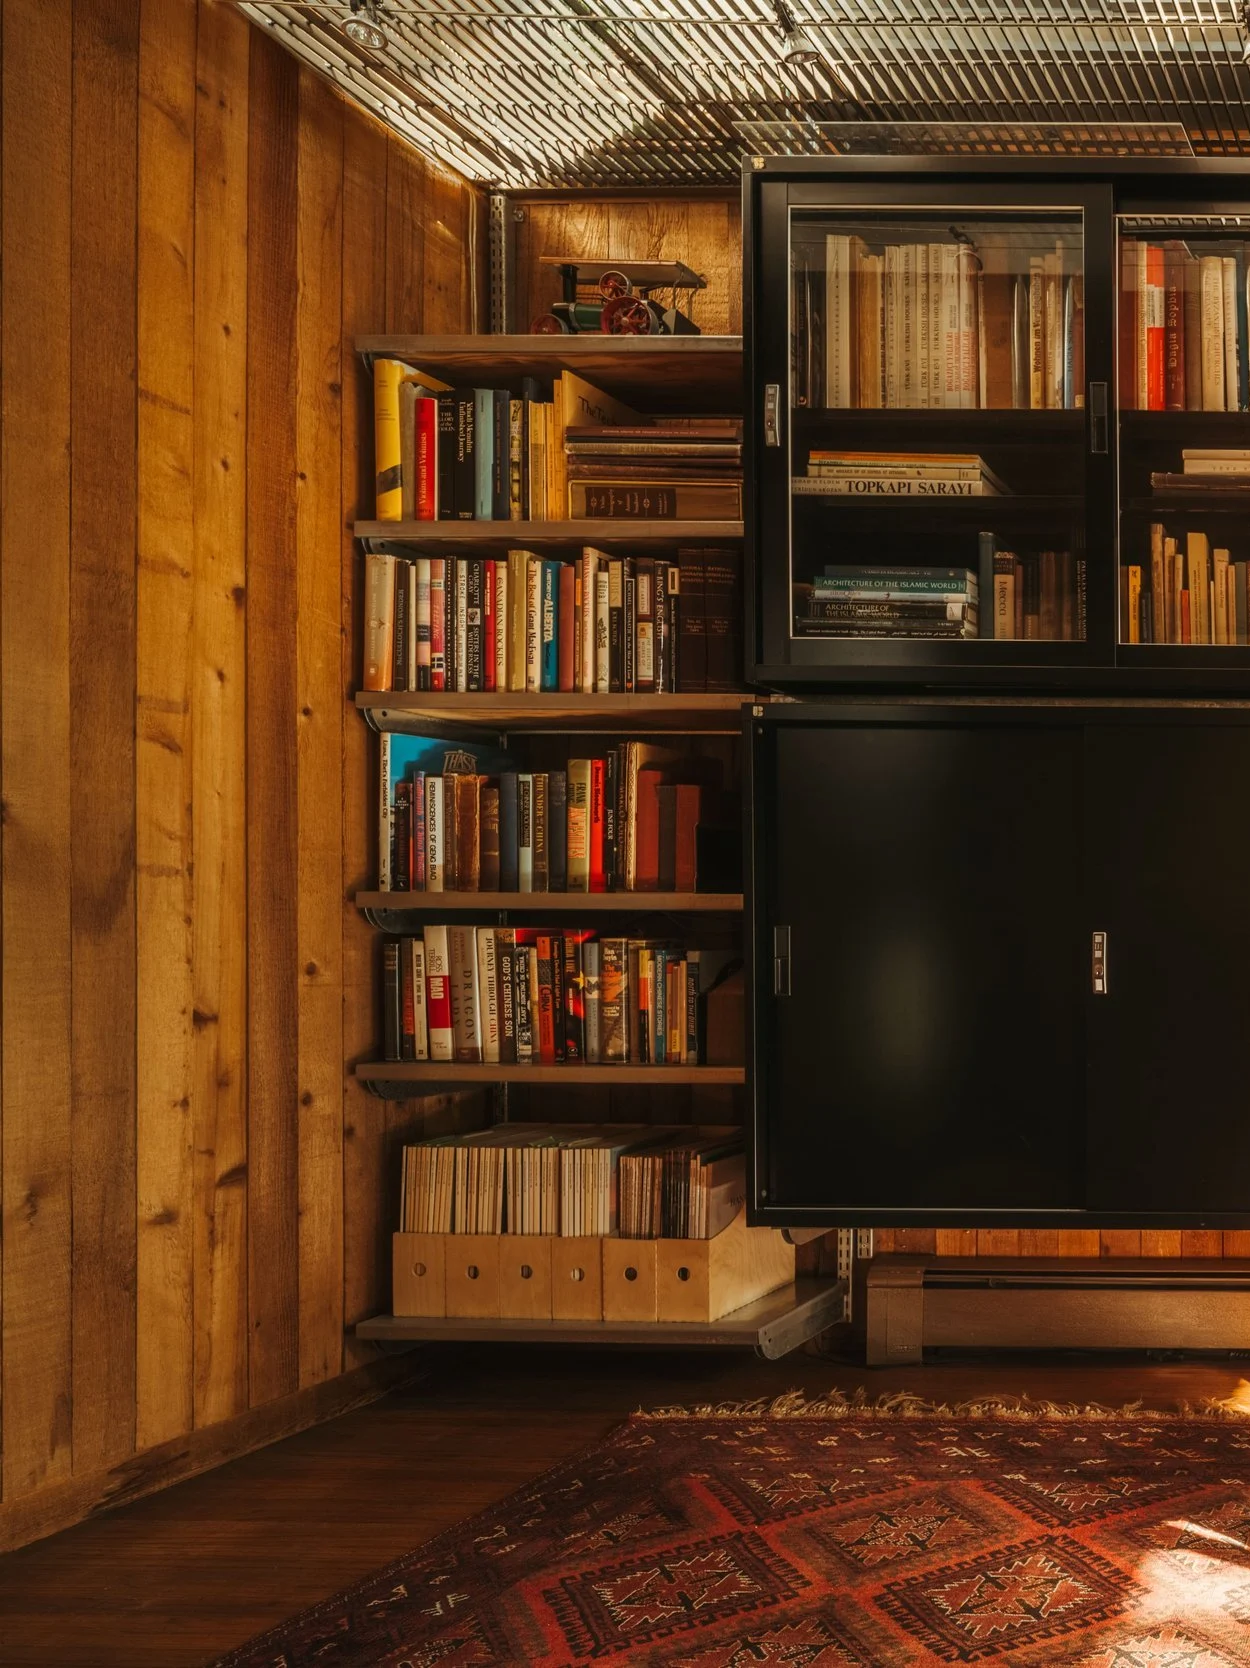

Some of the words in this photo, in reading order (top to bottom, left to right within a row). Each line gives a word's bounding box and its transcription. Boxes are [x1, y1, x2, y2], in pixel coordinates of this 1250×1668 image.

[1033, 341, 1041, 373] Wohnen
[419, 432, 427, 465] Violinists
[457, 437, 466, 463] Journey
[419, 466, 427, 480] and
[419, 480, 427, 505] Violins
[846, 480, 912, 494] TOPKAPI
[917, 481, 973, 495] SARAYI
[527, 569, 537, 583] The
[610, 567, 621, 603] TRIBES
[656, 576, 665, 602] KING'S
[823, 579, 873, 587] ARCHITECTURE
[874, 580, 884, 588] OF
[900, 581, 929, 589] ISLAMIC
[930, 581, 957, 589] WORLD
[496, 577, 504, 626] CANADIAN
[527, 584, 537, 600] Best
[527, 600, 537, 610] of
[999, 581, 1008, 616] Mecca
[527, 610, 537, 631] Grant
[543, 599, 553, 643] ALBERTA
[825, 604, 879, 612] ARCHITECTURE
[656, 604, 664, 640] ENGLISH
[473, 654, 480, 663] IN
[496, 628, 504, 667] ROCKIES
[527, 632, 537, 665] MacEwan
[536, 777, 544, 817] THUNDER
[576, 782, 586, 804] FRANK
[593, 788, 601, 824] Bloodworth
[429, 781, 437, 832] REMINISCENCES
[430, 834, 437, 843] OF
[536, 826, 544, 853] CHINA
[428, 948, 436, 973] TERRILL
[485, 937, 495, 973] JOURNEY
[565, 937, 575, 958] CHINA
[502, 956, 511, 981] GOD'S
[565, 959, 575, 973] LIVE
[430, 977, 444, 999] MAO
[487, 974, 496, 1015] THROUGH
[503, 983, 512, 1018] CHINESE
[541, 986, 551, 1014] CHINA
[462, 969, 475, 1040] DRAGON
[488, 1018, 497, 1044] CHINA
[504, 1020, 513, 1037] SON
